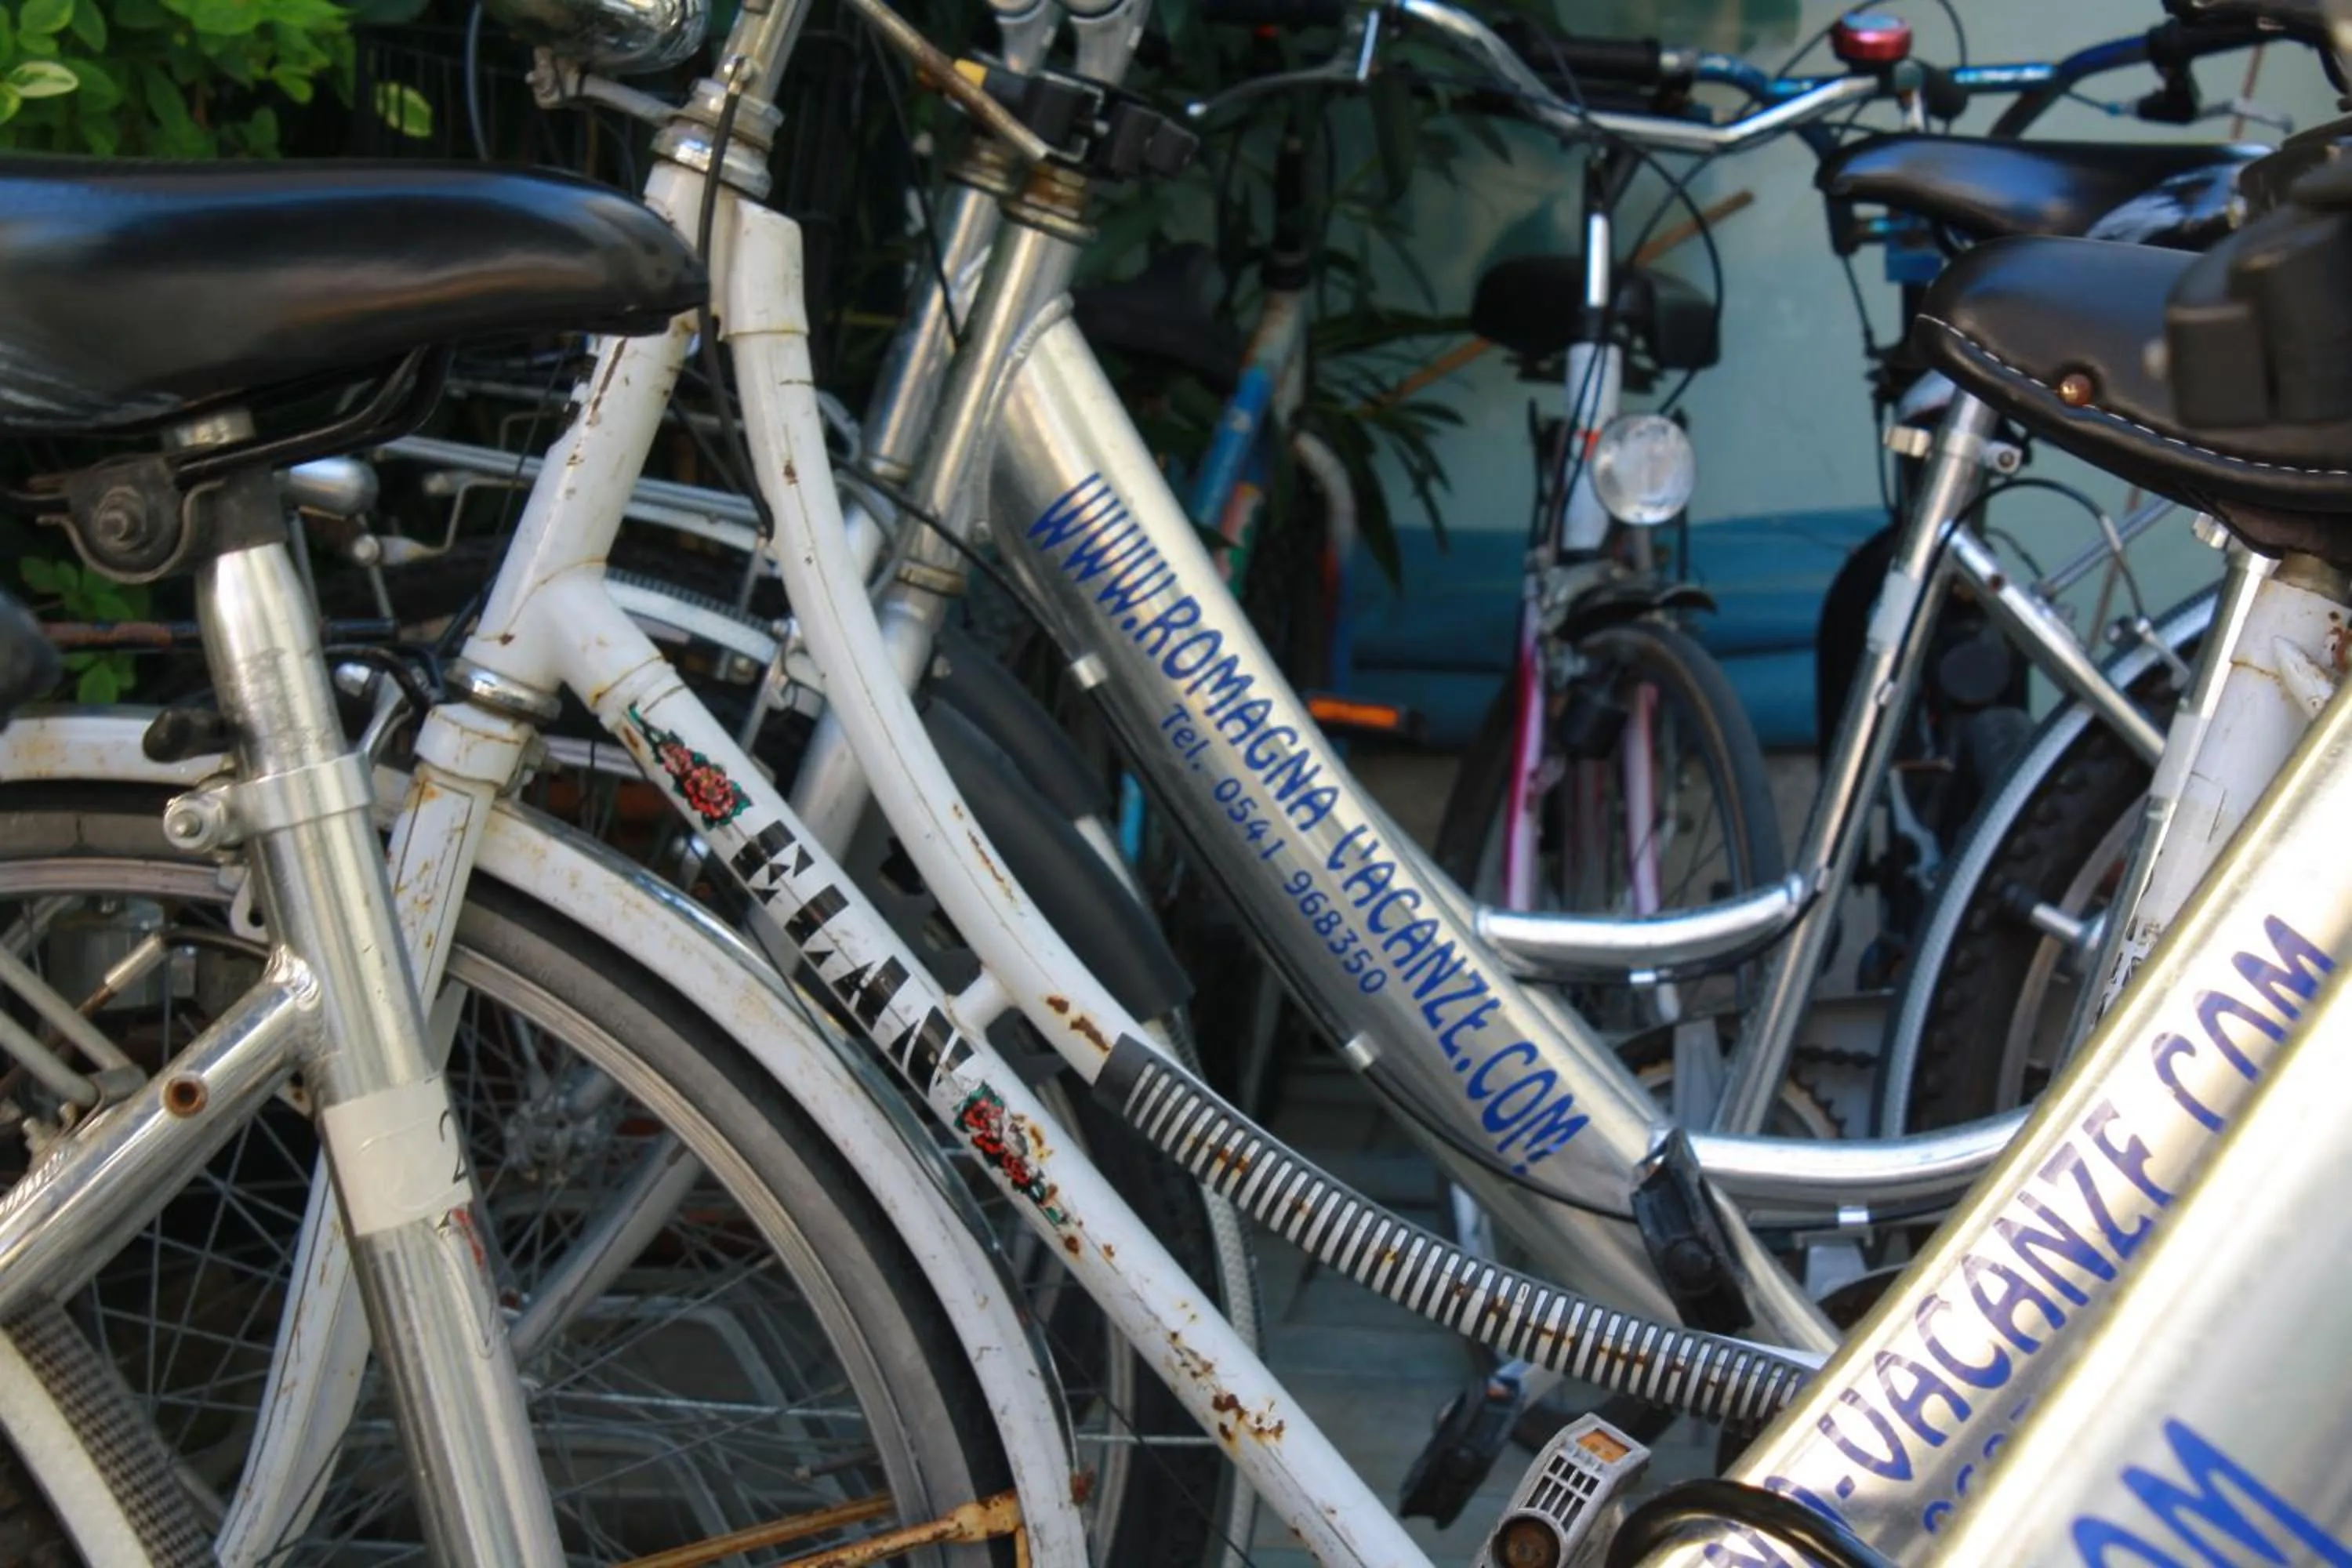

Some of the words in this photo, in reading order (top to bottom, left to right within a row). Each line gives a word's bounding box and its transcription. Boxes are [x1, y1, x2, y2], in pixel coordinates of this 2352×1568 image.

[1161, 703, 1210, 771] Tel.
[1214, 778, 1286, 860] 0541
[1283, 869, 1388, 994] 968350
